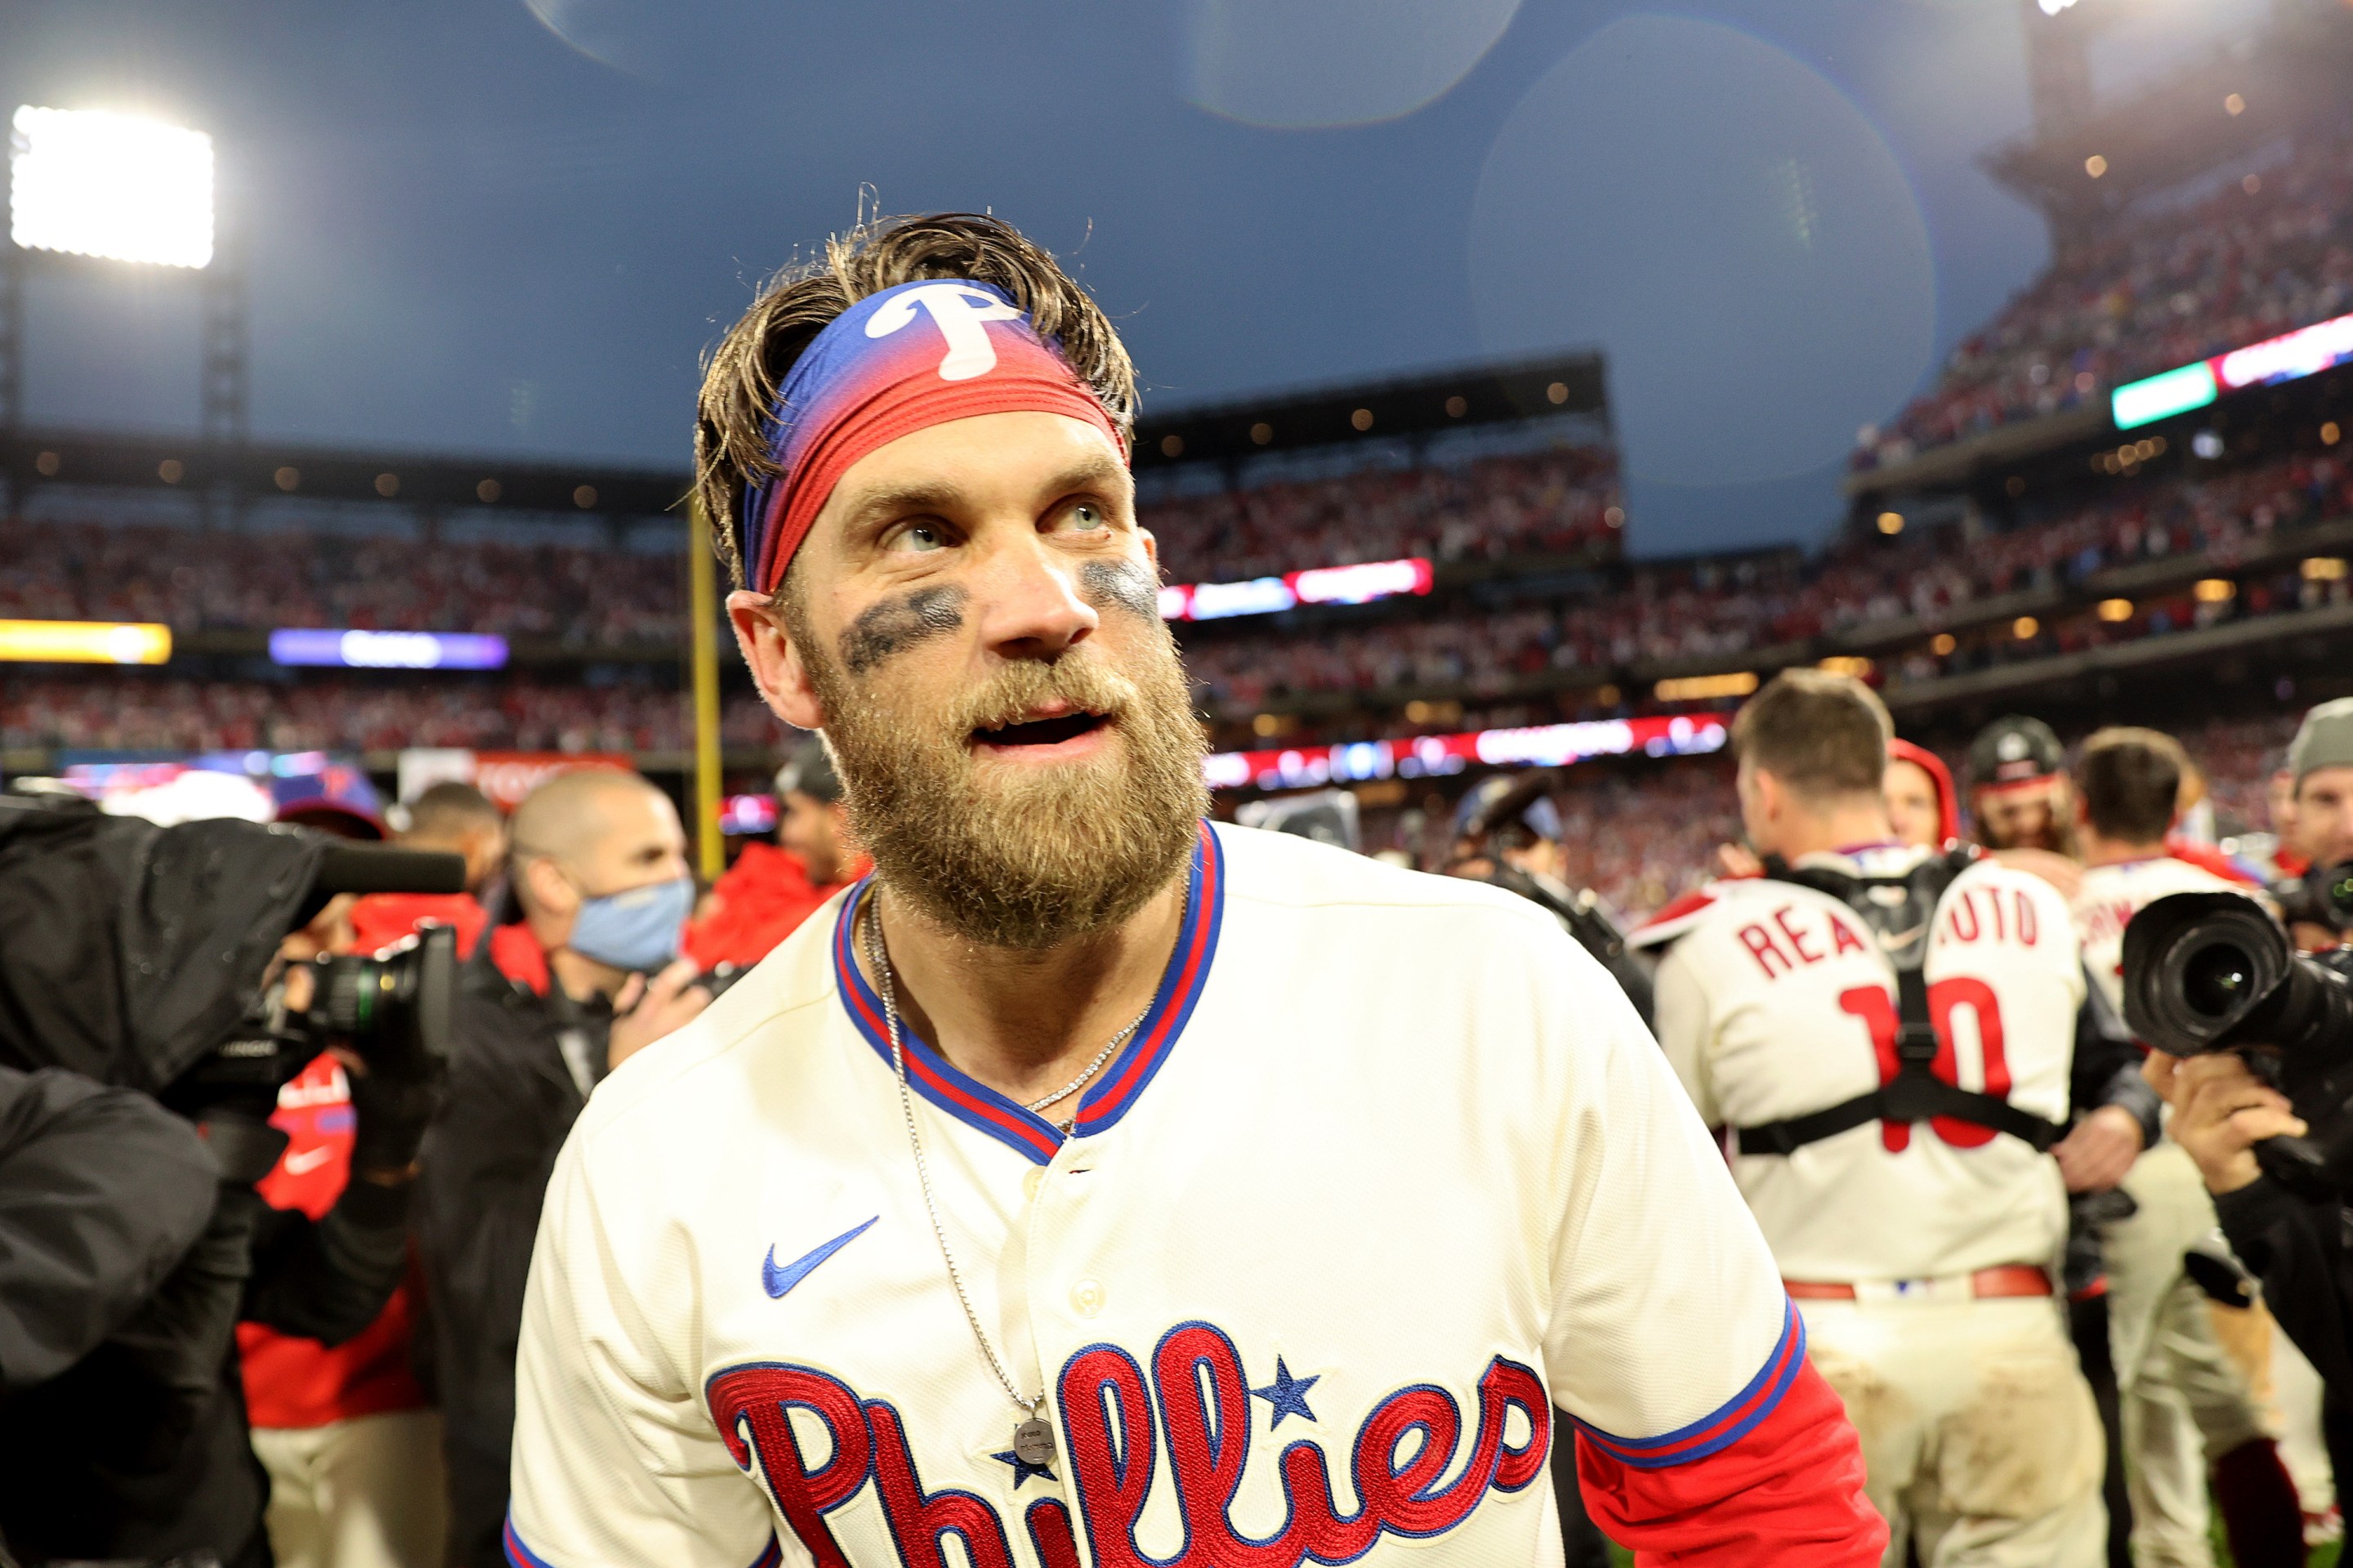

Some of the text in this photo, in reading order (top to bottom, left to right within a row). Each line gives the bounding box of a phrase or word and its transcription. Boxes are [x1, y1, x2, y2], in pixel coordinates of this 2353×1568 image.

[864, 284, 1024, 381] P
[1839, 977, 2011, 1153] 10
[705, 1319, 1550, 1568] Phillies
